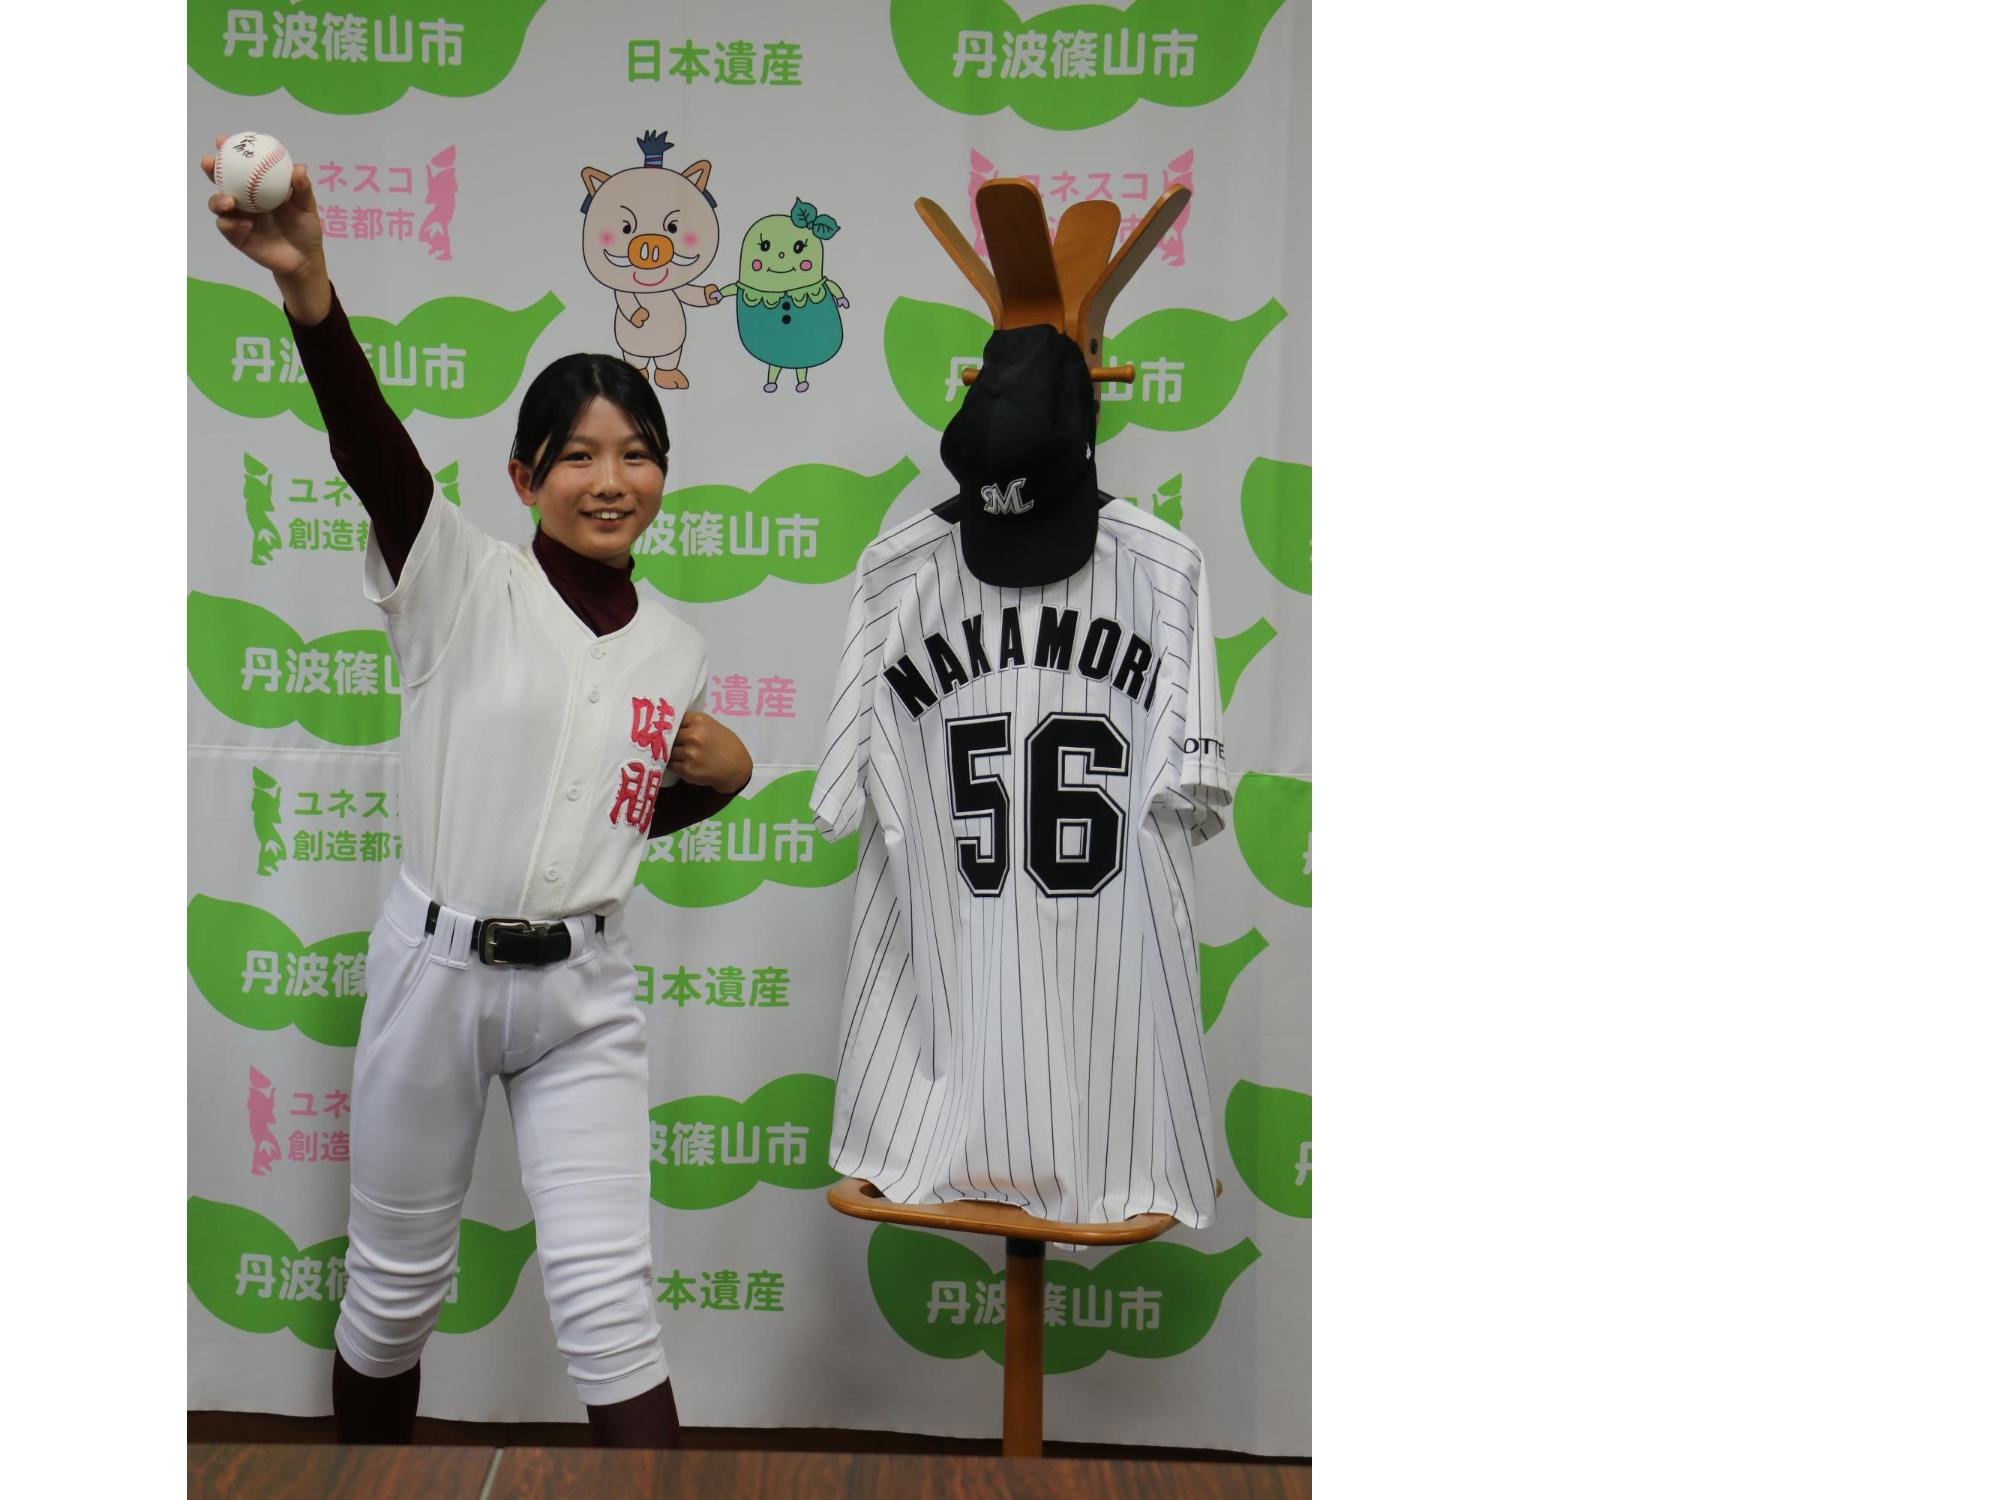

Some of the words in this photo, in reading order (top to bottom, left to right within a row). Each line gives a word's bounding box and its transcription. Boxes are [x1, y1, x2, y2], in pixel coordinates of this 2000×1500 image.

[223, 9, 465, 66] 丹波篠山市
[952, 27, 1198, 79] 丹波篠山市
[627, 39, 803, 85] 日本遺産
[317, 160, 414, 193] ネスコ
[318, 206, 416, 241] 造都市
[231, 336, 467, 390] 丹山市
[288, 476, 362, 507] ユネ
[288, 517, 368, 552] 創造
[632, 509, 820, 560] 波篠山市
[240, 647, 401, 695] 丹波篠
[710, 673, 798, 719] 遺産
[1184, 737, 1226, 761] OTTE
[294, 788, 399, 819] ユネス
[945, 711, 1131, 898] 56
[640, 818, 816, 863] 篠山市
[241, 950, 368, 998] 丹波篠
[289, 1089, 351, 1119] ユネ
[288, 1130, 350, 1162] 創造
[657, 1269, 785, 1312] 本遺産
